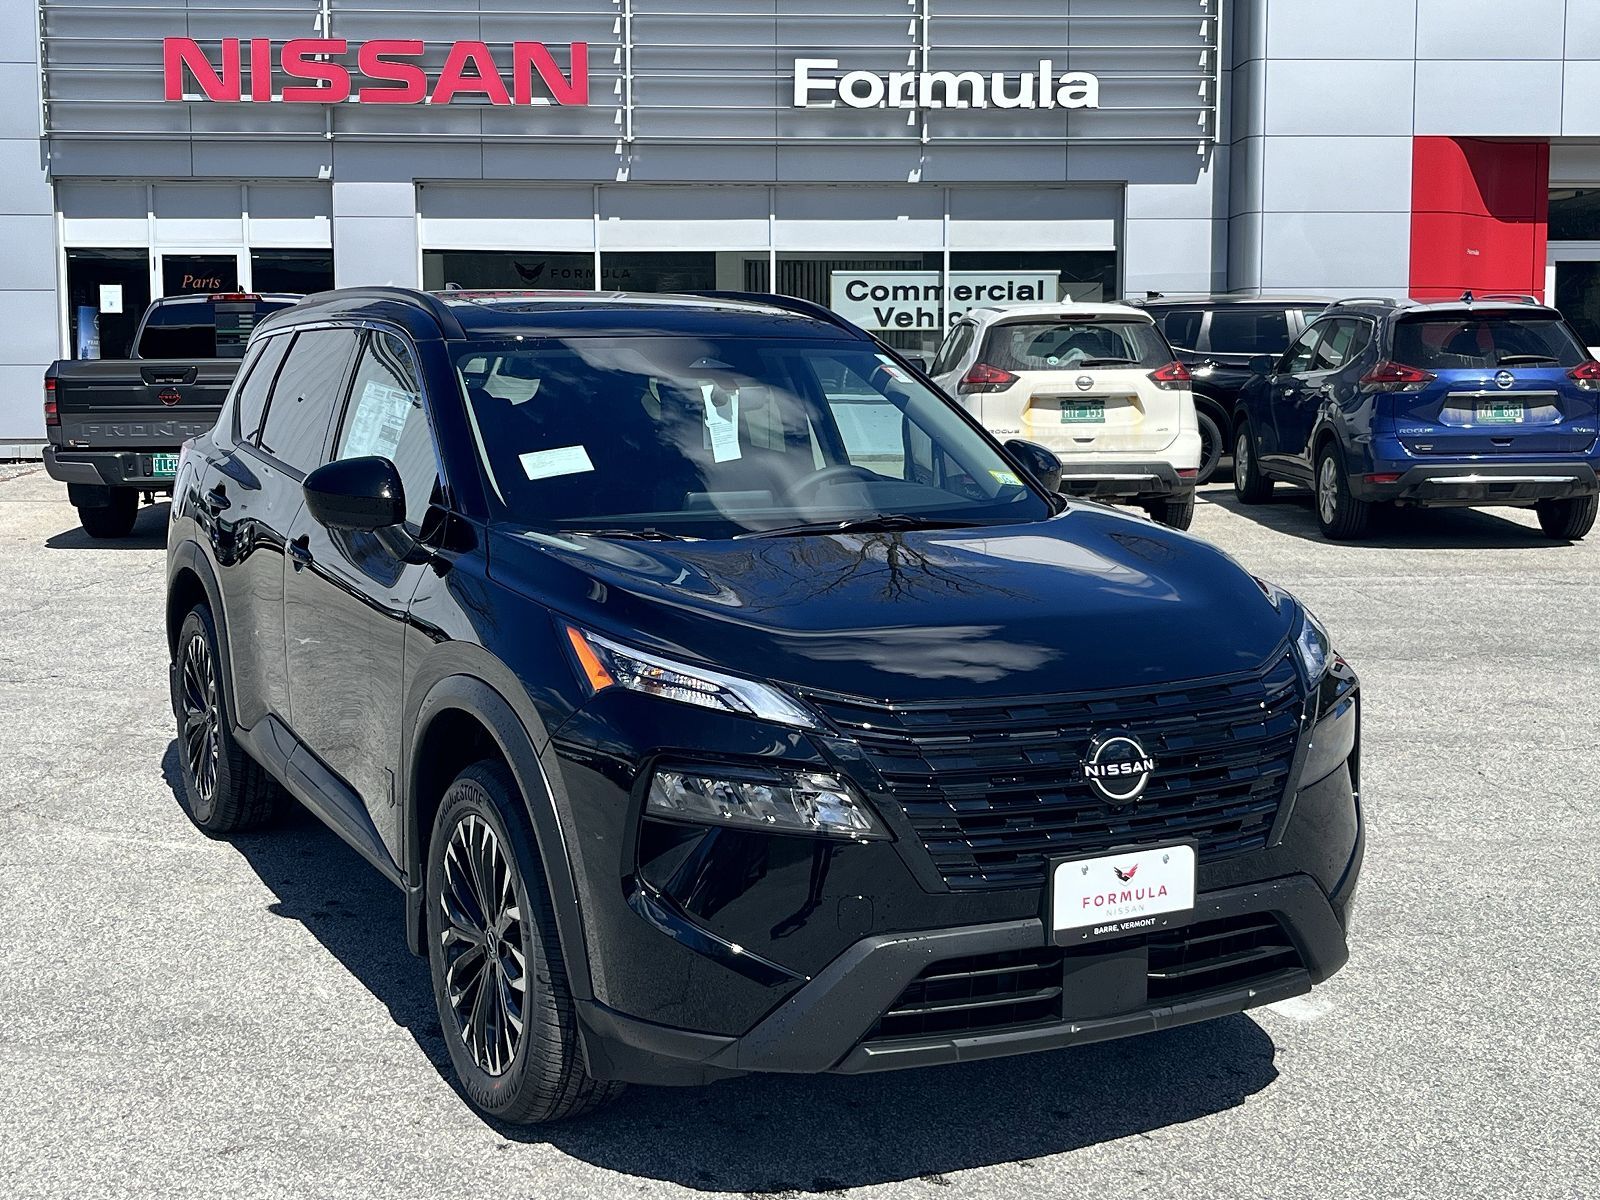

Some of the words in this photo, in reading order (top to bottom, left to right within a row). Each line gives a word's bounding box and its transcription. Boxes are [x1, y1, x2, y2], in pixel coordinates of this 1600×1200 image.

[163, 37, 589, 106] NISSAN
[793, 58, 1100, 109] Formula
[181, 274, 221, 290] Parts
[550, 268, 631, 279] FORMULA
[845, 280, 1045, 301] Commercial
[873, 306, 973, 328] Vehic
[81, 422, 208, 437] FRONT
[1084, 758, 1154, 777] NISSAN
[1082, 884, 1168, 909] FORMULA
[1106, 904, 1145, 917] NISSAN
[1093, 924, 1119, 935] BARRE,
[1120, 918, 1156, 930] VERMONT
